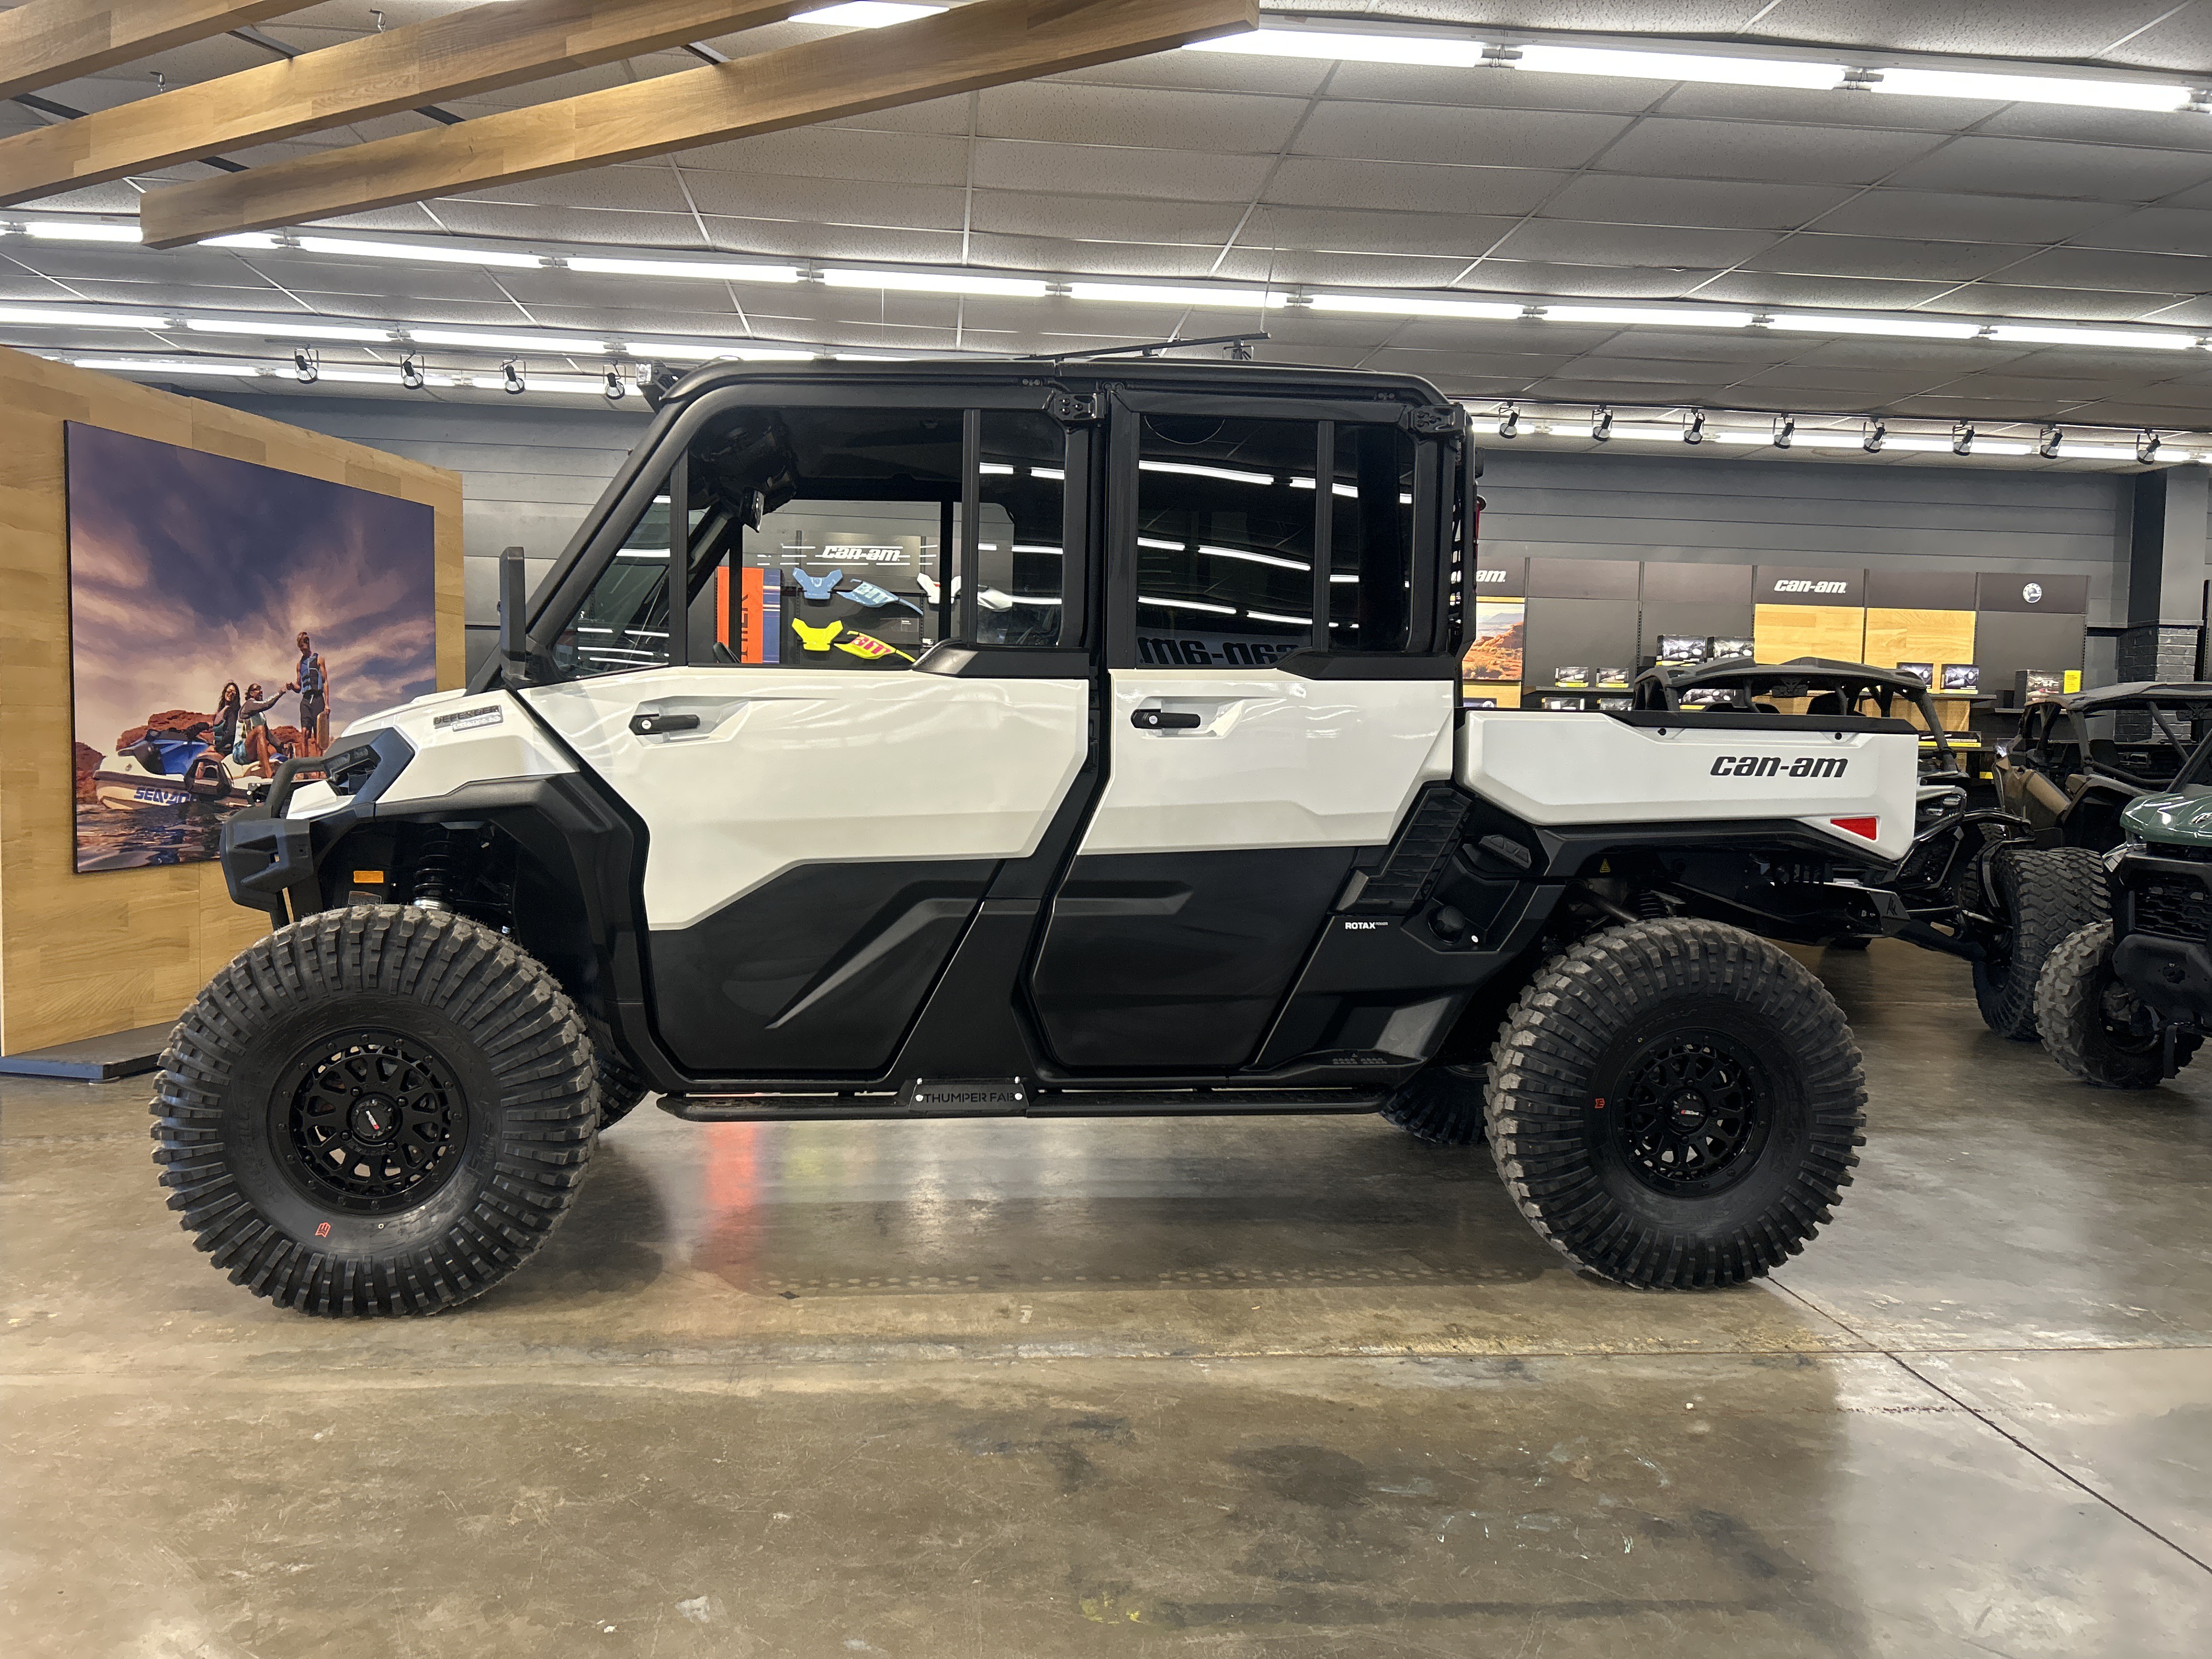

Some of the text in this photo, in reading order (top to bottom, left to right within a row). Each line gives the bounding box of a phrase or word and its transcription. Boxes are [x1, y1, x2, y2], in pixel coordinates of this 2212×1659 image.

[1774, 580, 1847, 593] can-am
[433, 706, 499, 725] DEFENDER
[1710, 756, 1848, 777] can-am
[923, 1092, 988, 1103] THUMPER
